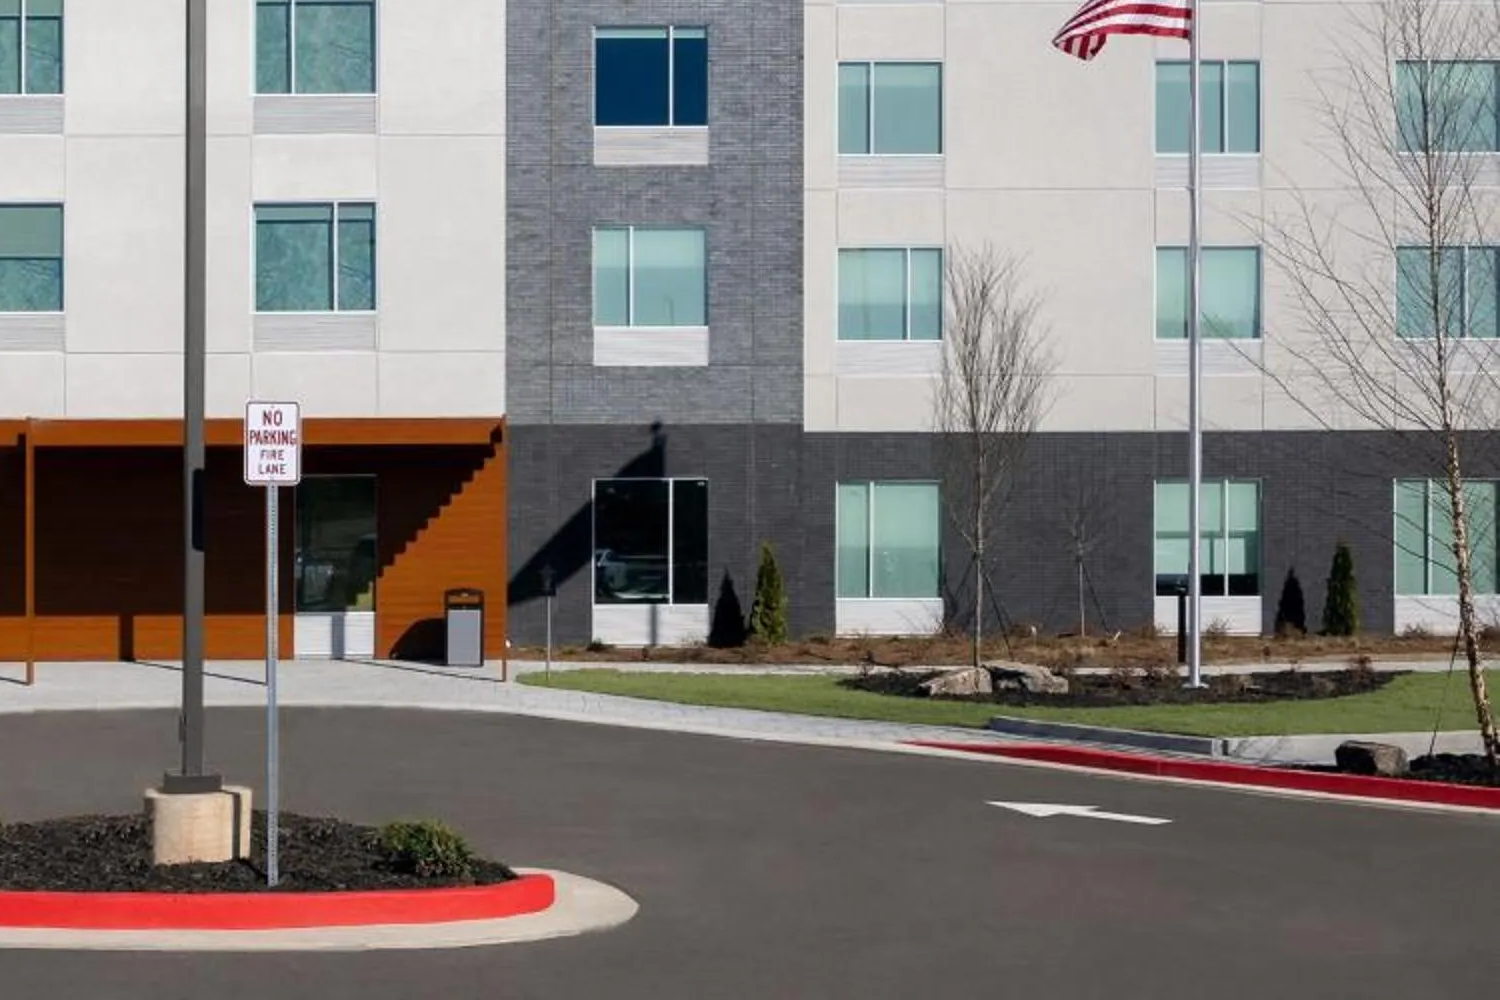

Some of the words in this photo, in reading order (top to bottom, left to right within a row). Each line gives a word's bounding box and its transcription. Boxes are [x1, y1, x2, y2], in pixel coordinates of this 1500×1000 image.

[262, 409, 283, 427] NO
[249, 430, 297, 446] PARKING
[260, 449, 285, 461] FIRE
[258, 463, 287, 475] LANE
